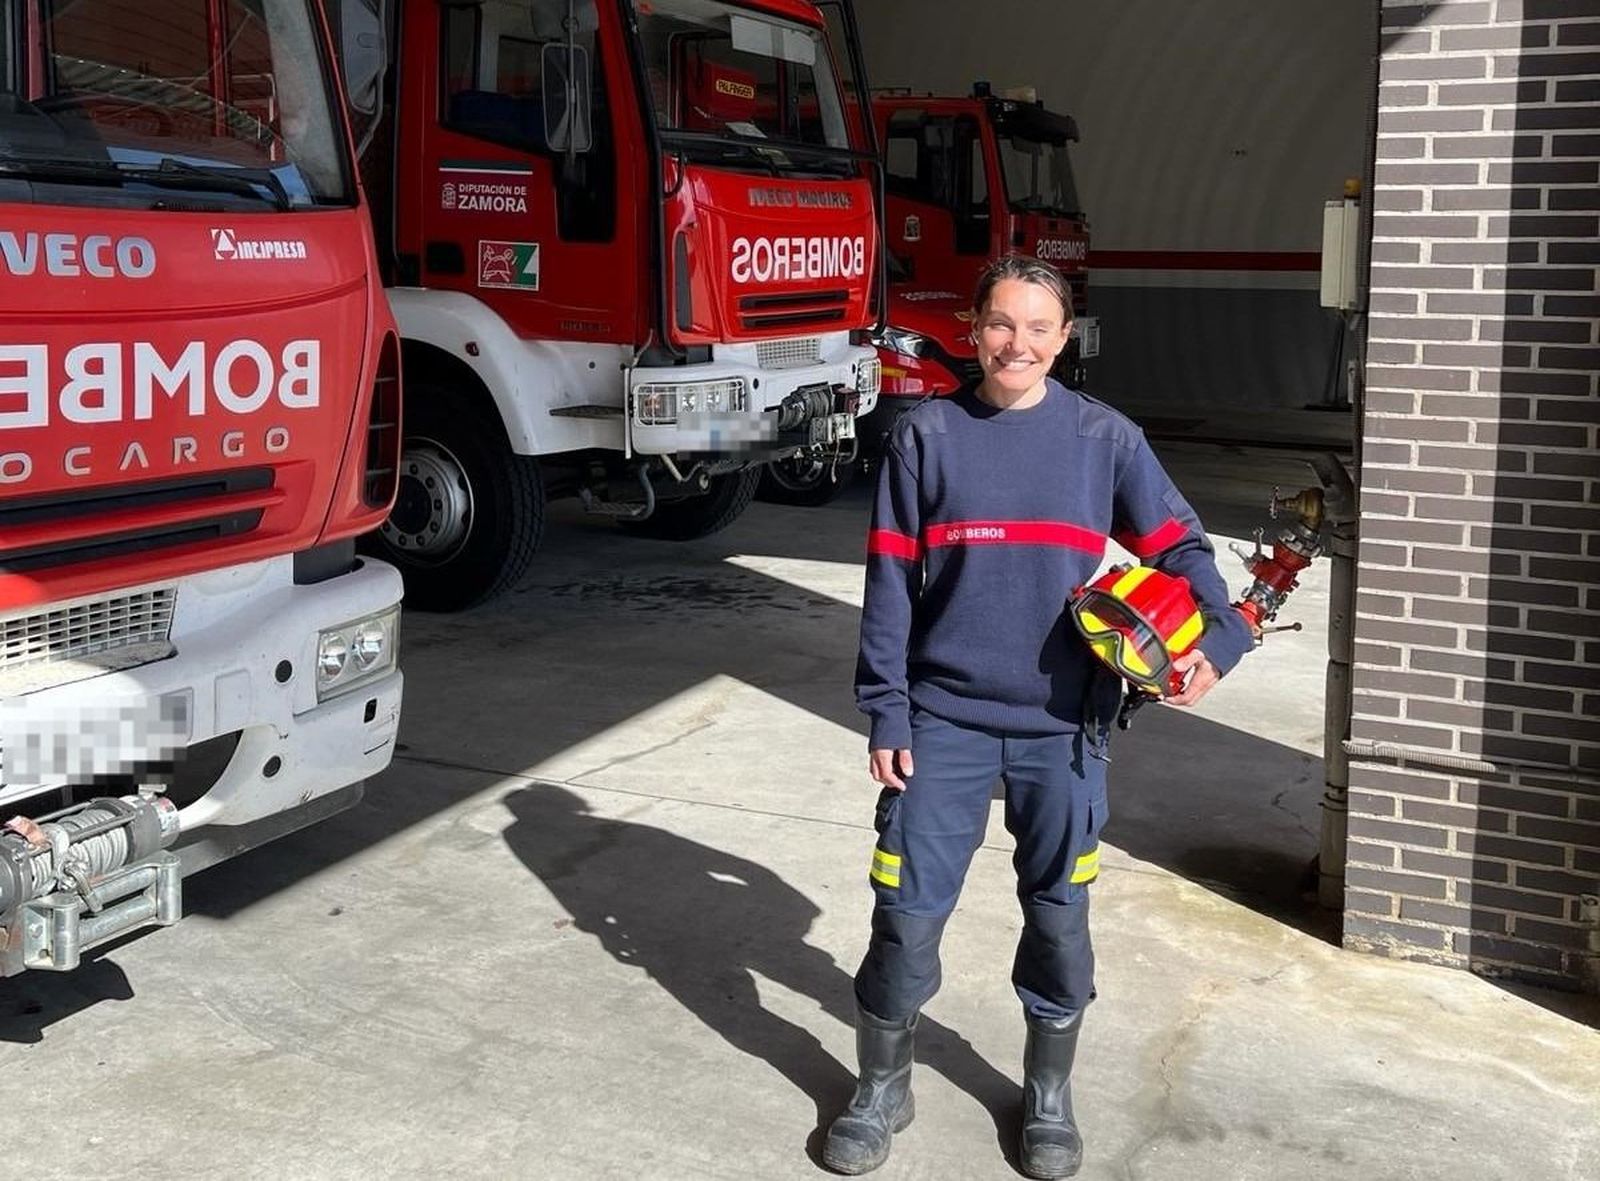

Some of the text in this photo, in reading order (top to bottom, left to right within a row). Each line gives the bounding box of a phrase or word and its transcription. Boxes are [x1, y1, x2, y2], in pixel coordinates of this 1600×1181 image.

[458, 183, 527, 196] DIPUTACIÓN DE
[458, 195, 527, 213] ZAMORA
